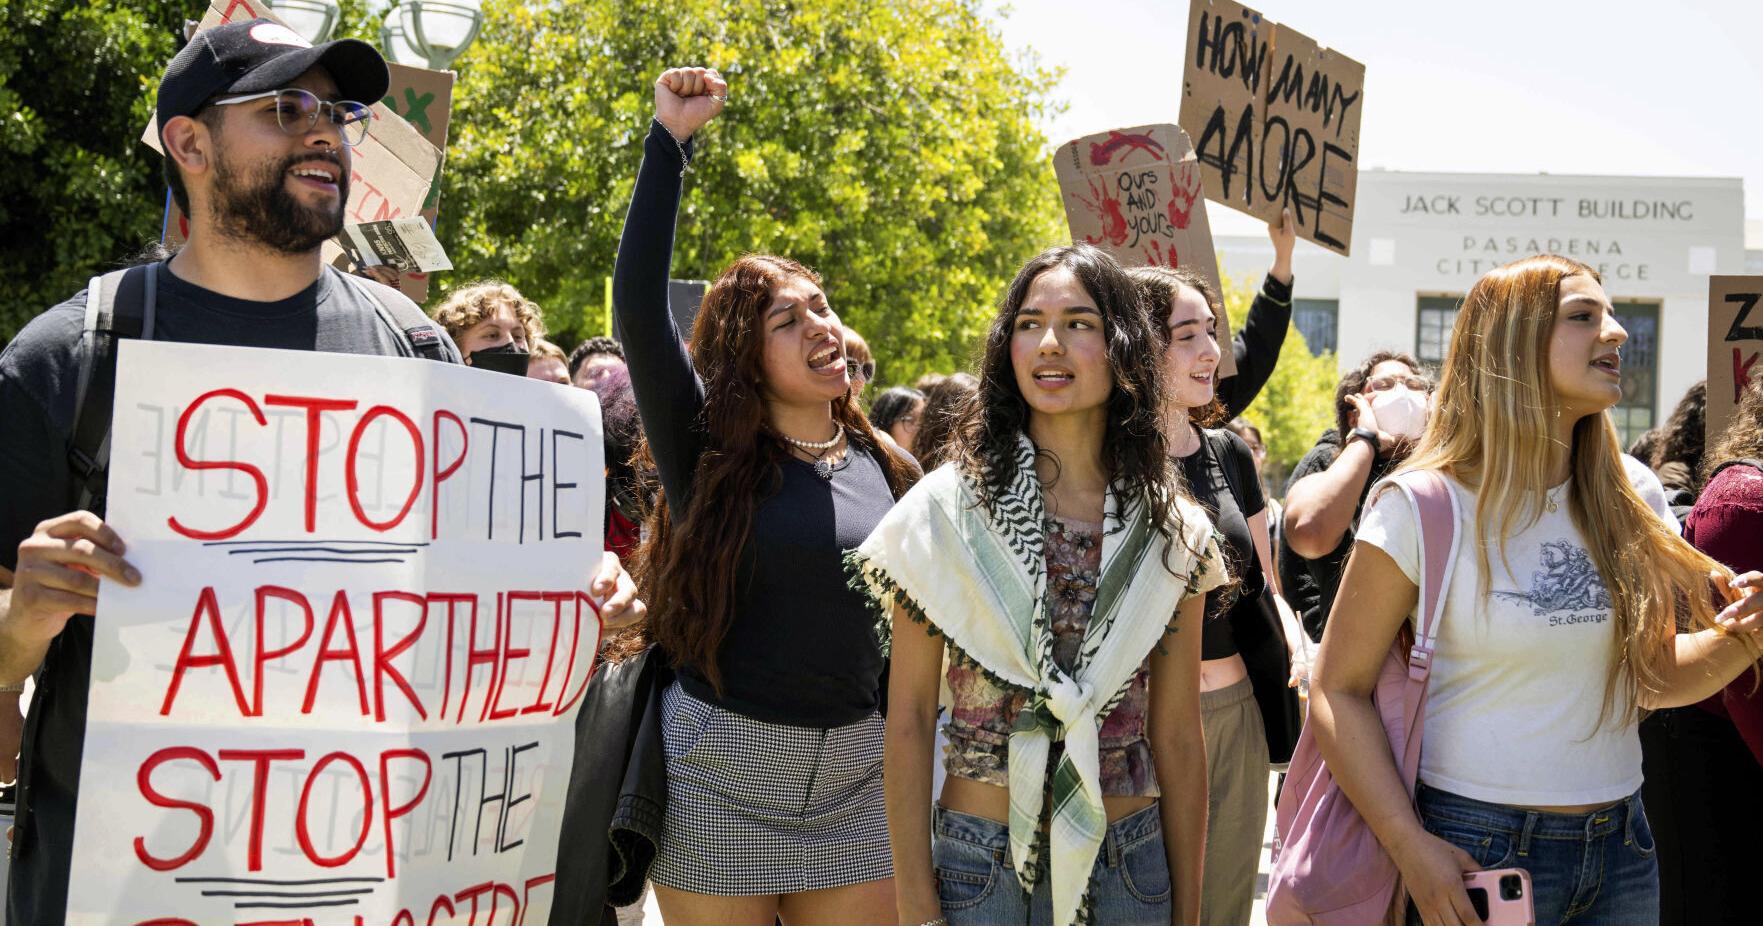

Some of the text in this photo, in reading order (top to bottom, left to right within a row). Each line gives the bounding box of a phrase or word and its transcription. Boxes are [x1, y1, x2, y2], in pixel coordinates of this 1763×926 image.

[1197, 10, 1359, 137] HOW MANY
[1126, 188, 1156, 212] AND
[1196, 103, 1352, 250] MORE
[1400, 195, 1694, 221] JACK SCOTT BUILDING
[1463, 237, 1623, 255] PASADENA
[168, 388, 584, 544] STOP THE
[160, 585, 605, 725] APARTHEID
[133, 746, 432, 879] STOP
[442, 742, 539, 862] THE
